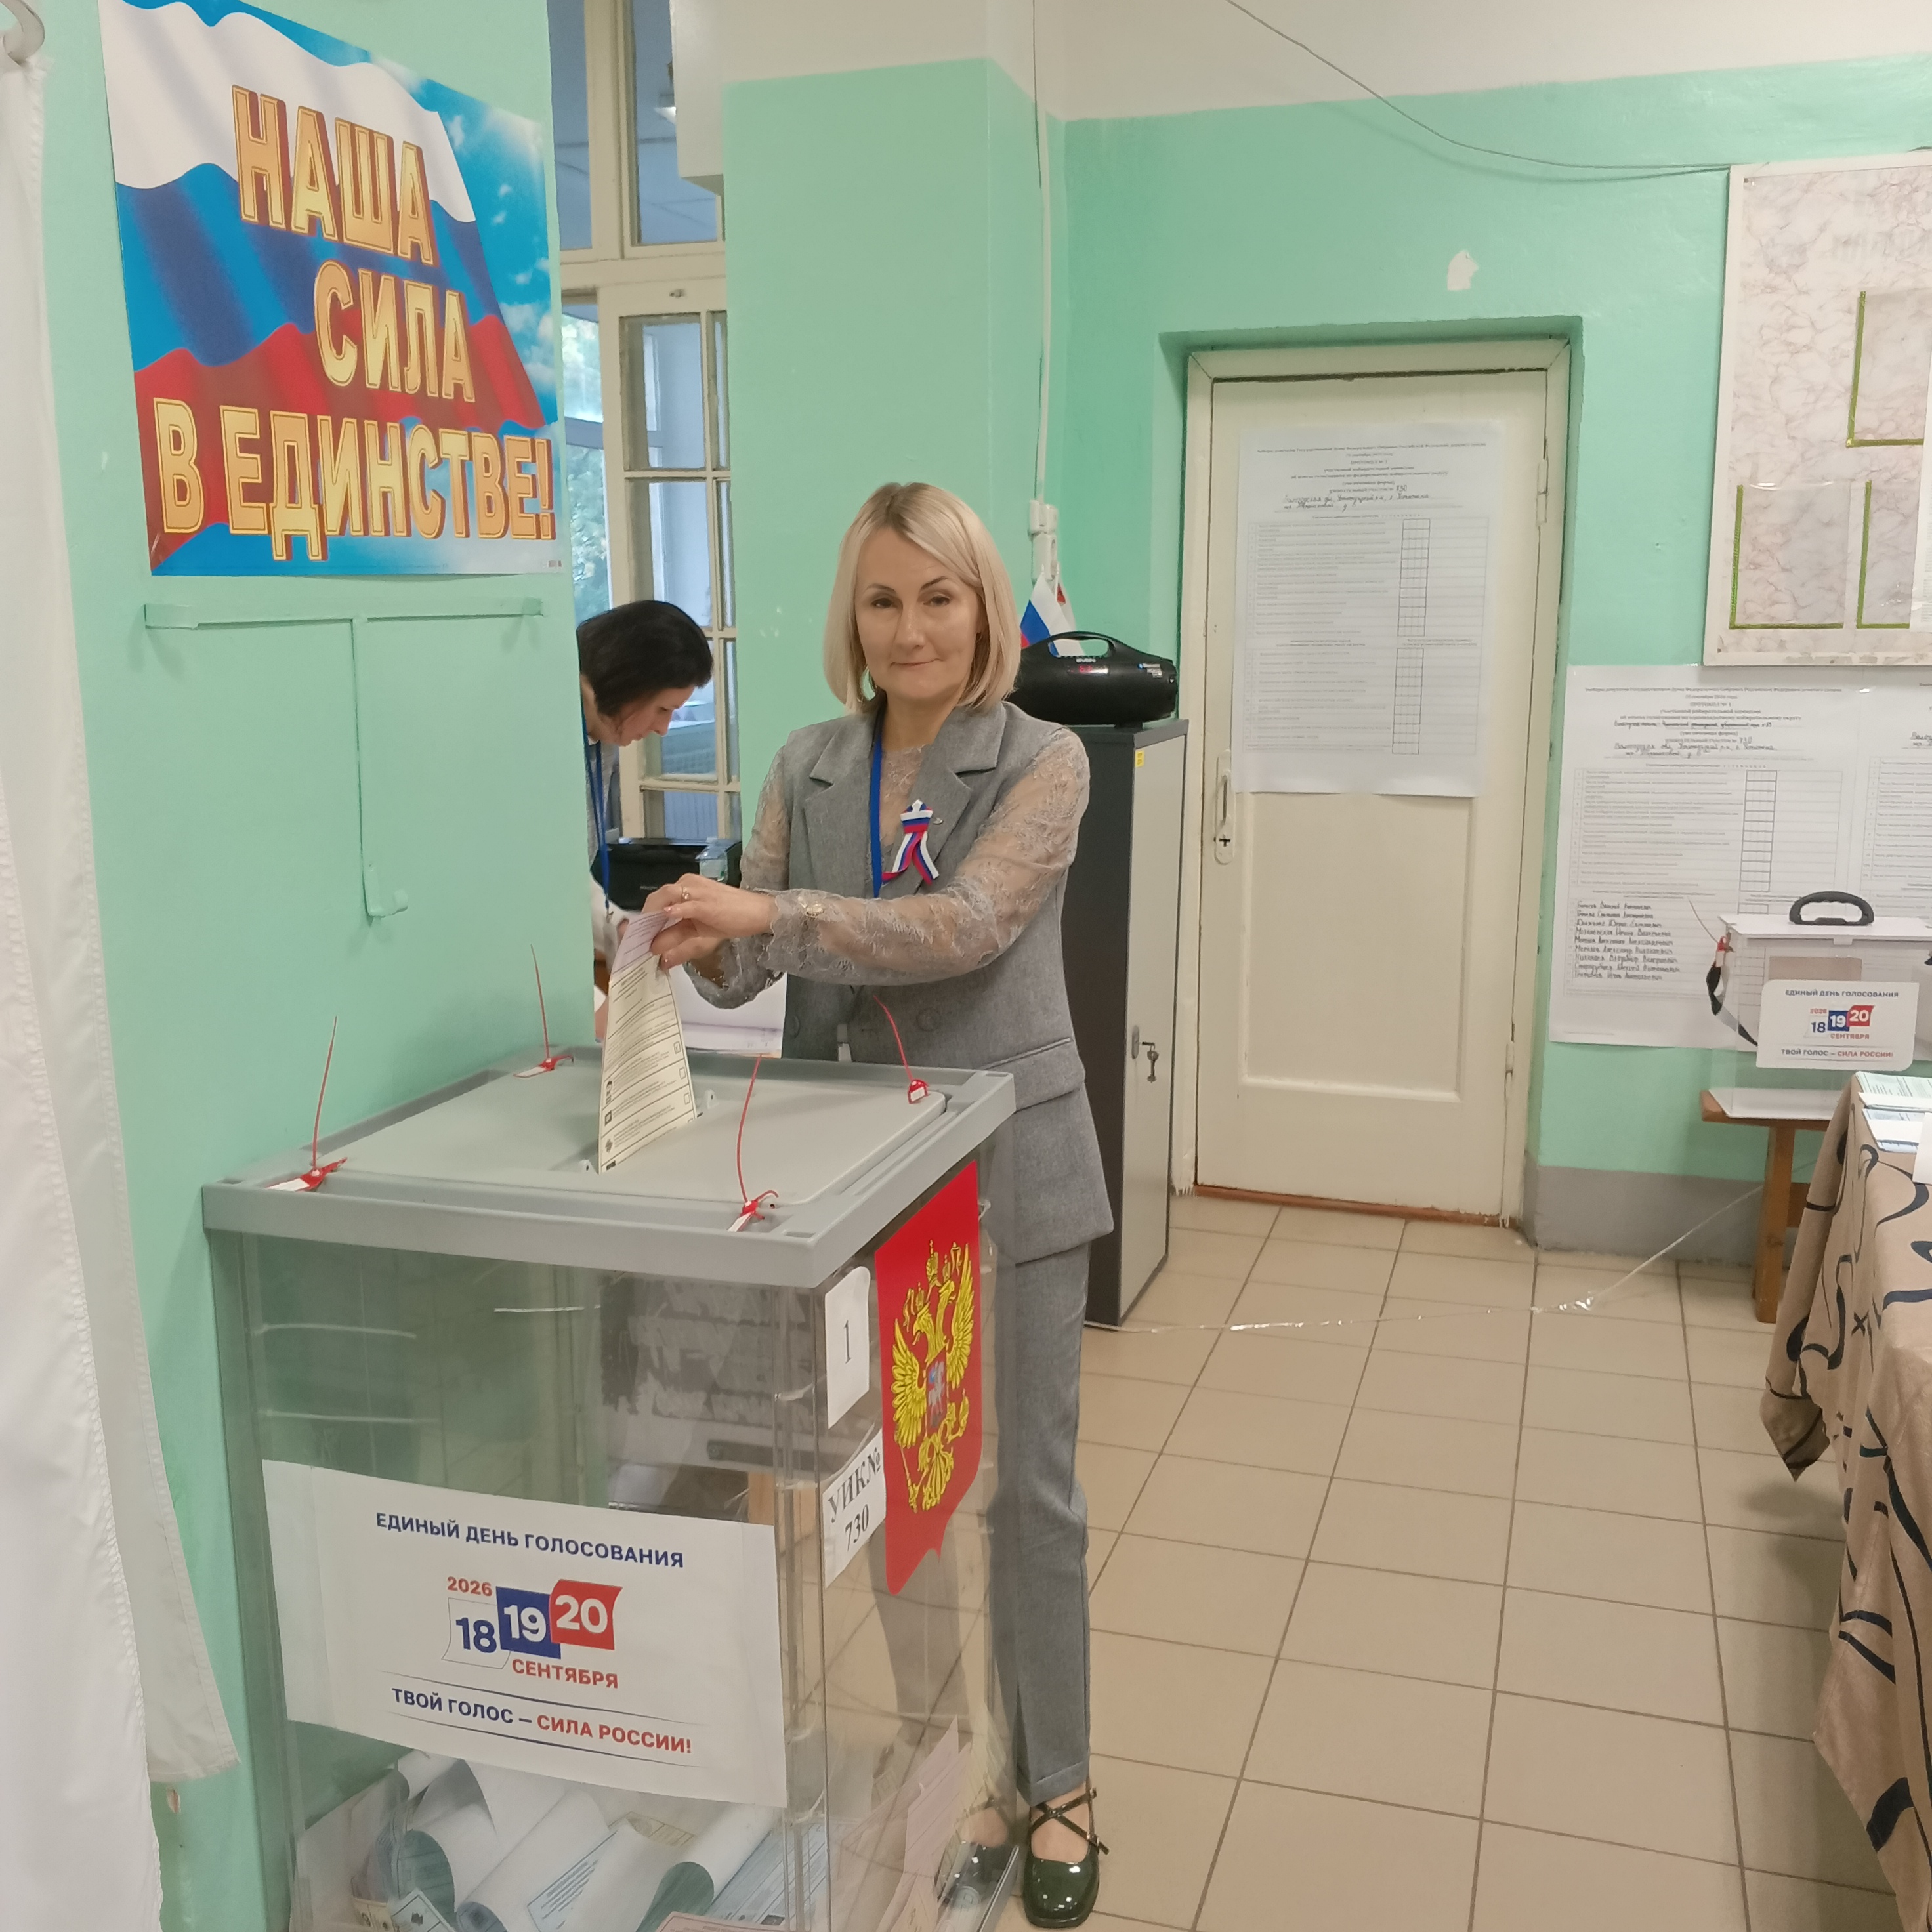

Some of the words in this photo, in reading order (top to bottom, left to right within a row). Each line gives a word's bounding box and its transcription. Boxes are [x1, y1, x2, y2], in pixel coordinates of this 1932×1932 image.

[231, 85, 437, 266] НАША
[312, 258, 476, 403] СИЛА
[153, 397, 205, 536] В
[219, 404, 556, 562] ЕДИНСТВЕ!
[1811, 1022, 1826, 1033] 18
[1830, 1015, 1846, 1028] 19
[1849, 1010, 1869, 1022] 20
[842, 1318, 852, 1365] 1
[375, 1511, 460, 1540] ЕДИНЫЙ
[465, 1526, 519, 1547] ДЕНЬ
[524, 1533, 684, 1568] ГОЛОСОВАНИЯ
[844, 1511, 870, 1553] 730
[446, 1576, 493, 1597] 2026
[455, 1617, 497, 1654] 18
[503, 1604, 547, 1643] 19
[555, 1595, 609, 1634] 20
[512, 1658, 619, 1689] СЕНТЯБРЯ
[392, 1687, 442, 1713] ТВОЙ
[448, 1698, 513, 1725] ГОЛОС
[537, 1714, 593, 1738] СИЛА
[598, 1725, 692, 1754] РОССИИ!
